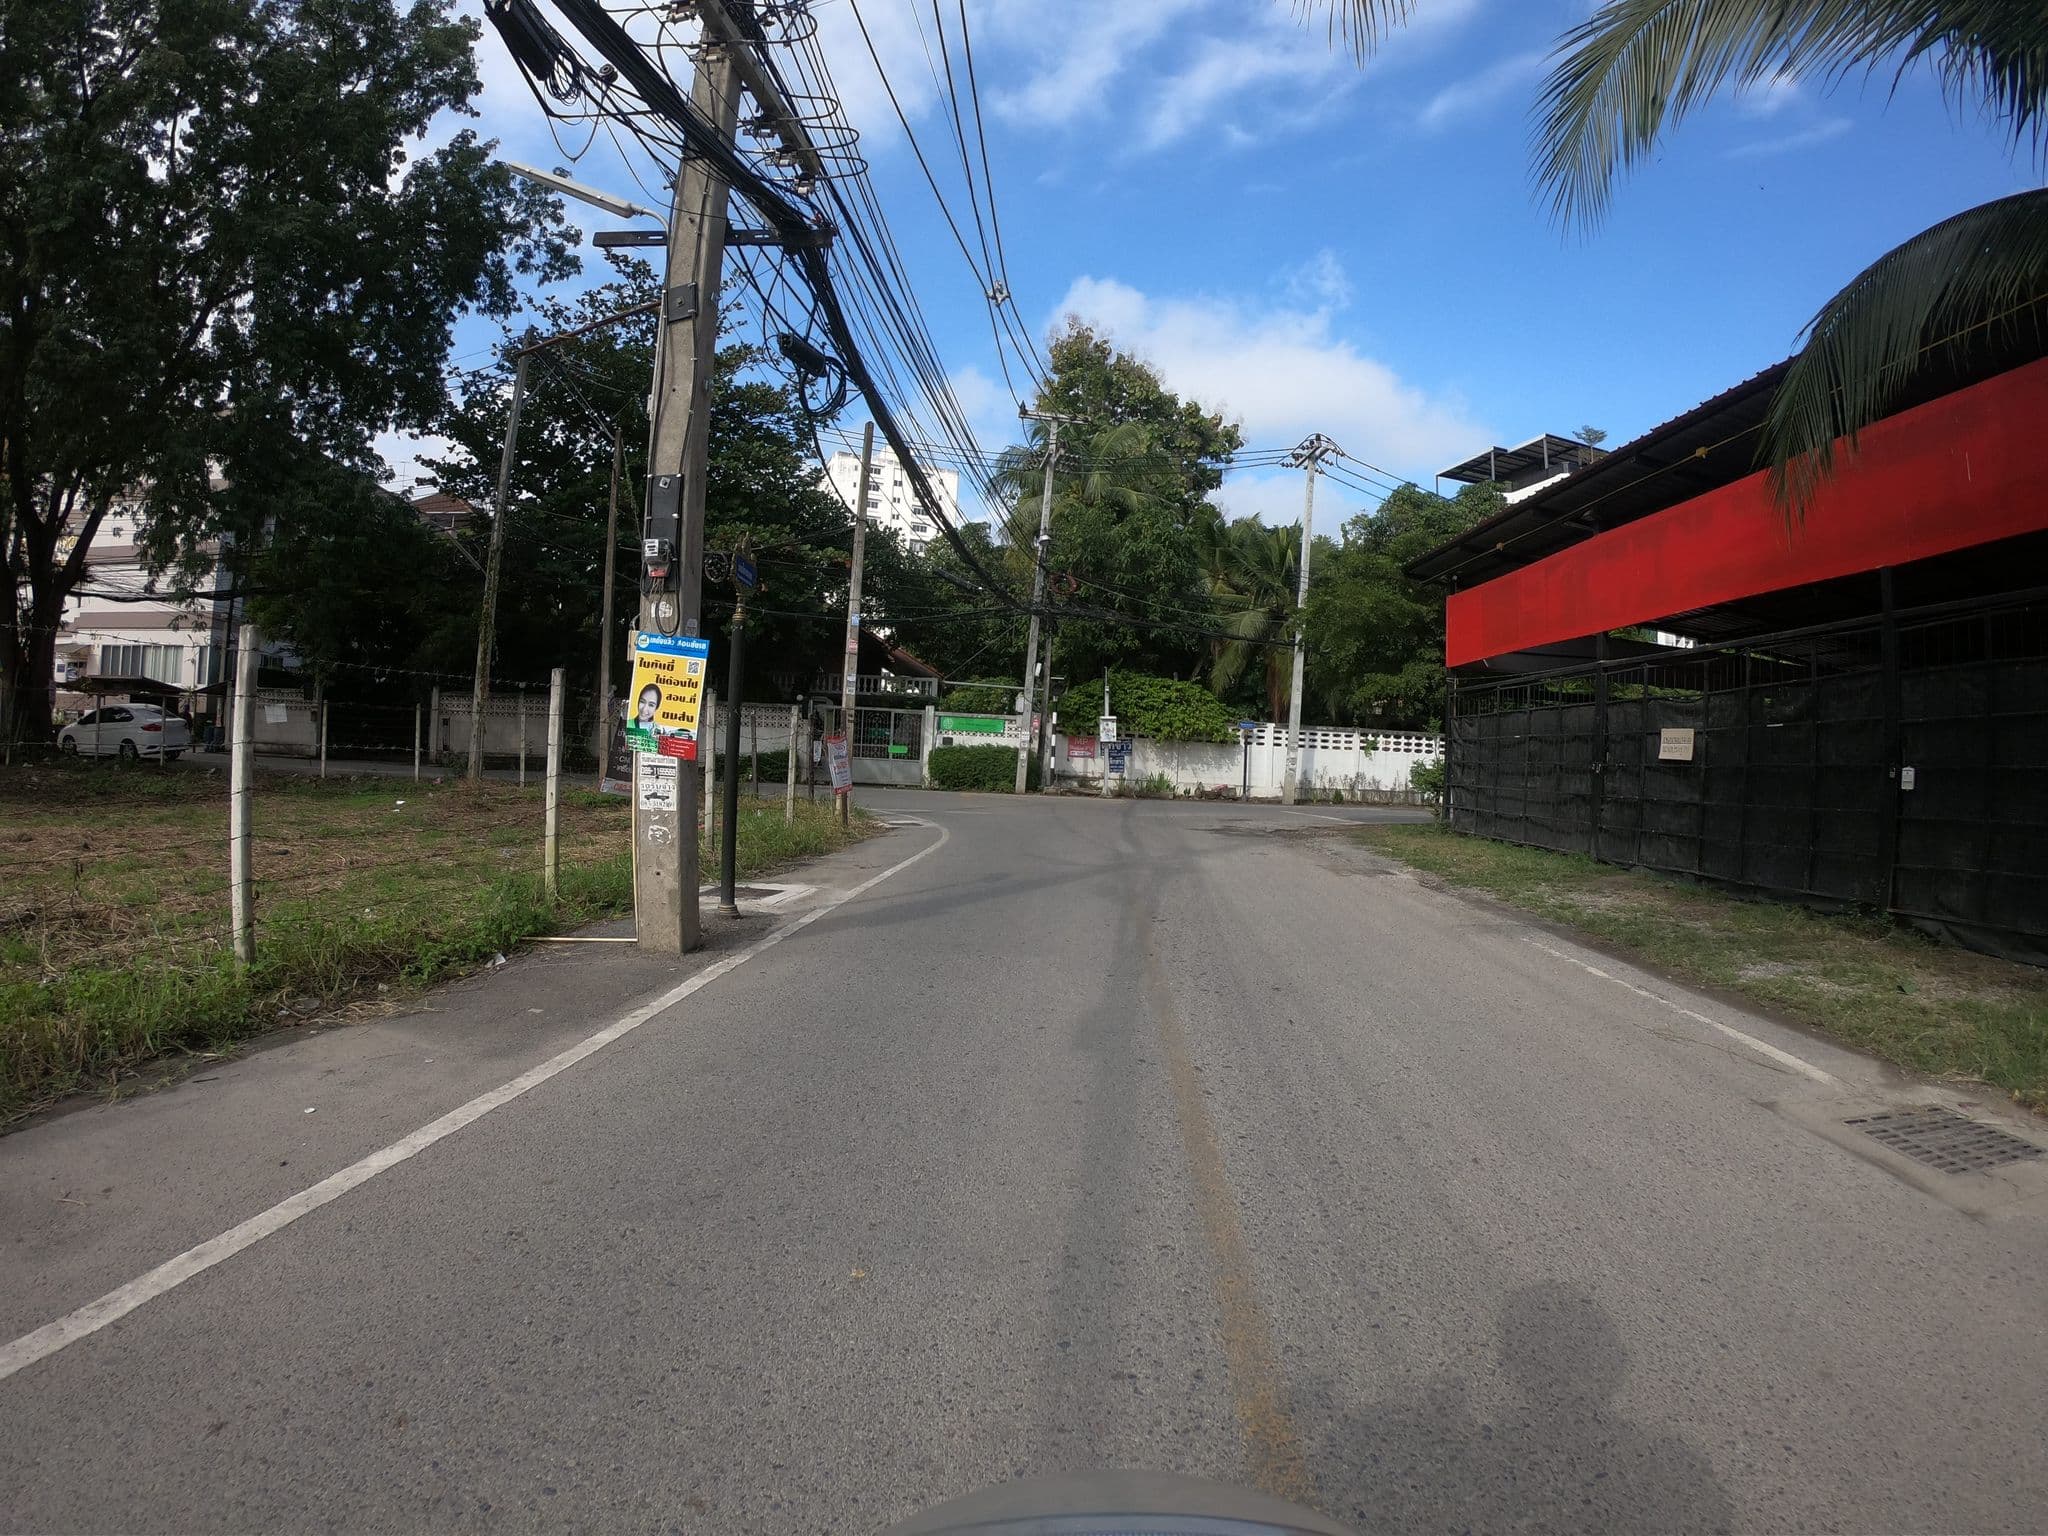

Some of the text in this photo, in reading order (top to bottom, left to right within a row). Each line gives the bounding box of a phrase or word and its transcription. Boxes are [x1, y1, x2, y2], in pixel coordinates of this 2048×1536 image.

[655, 673, 699, 689] ไม่ต้องไป
[662, 711, 694, 723] ขนส่ง
